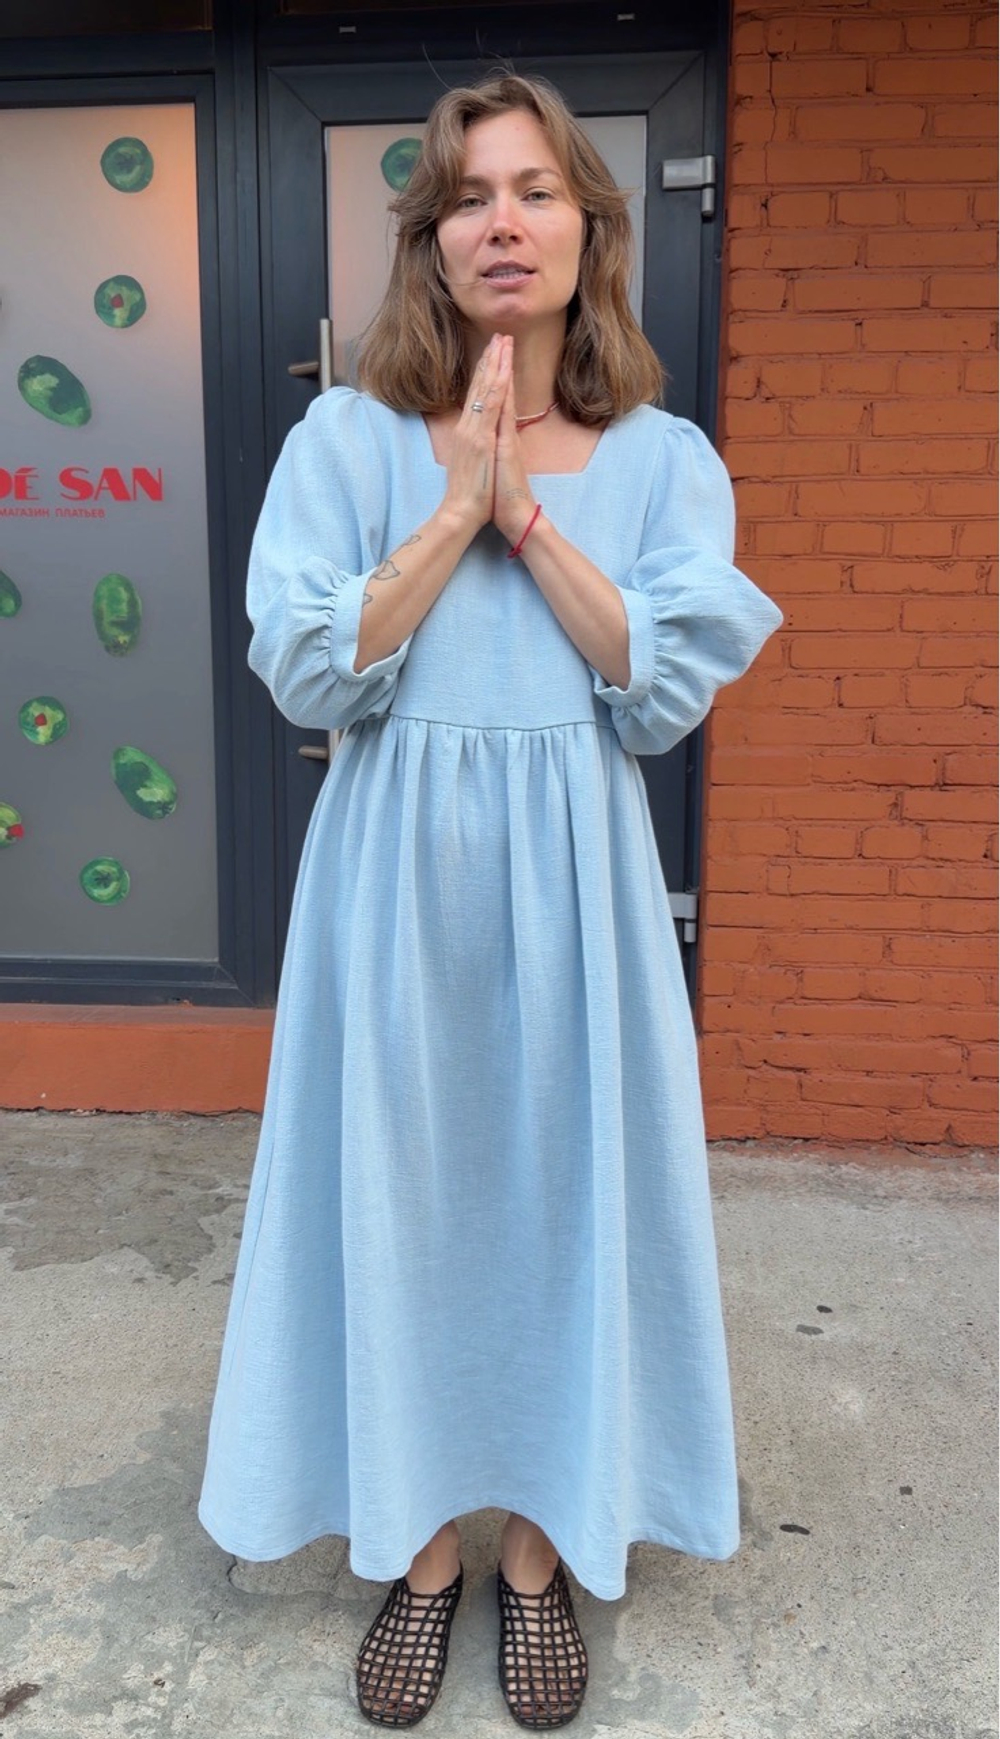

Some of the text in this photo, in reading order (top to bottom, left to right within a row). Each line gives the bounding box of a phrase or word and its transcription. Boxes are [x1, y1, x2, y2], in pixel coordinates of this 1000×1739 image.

[58, 466, 164, 501] SAN
[0, 507, 105, 518] МАГАЗИН ПЛАТЬЕВ
